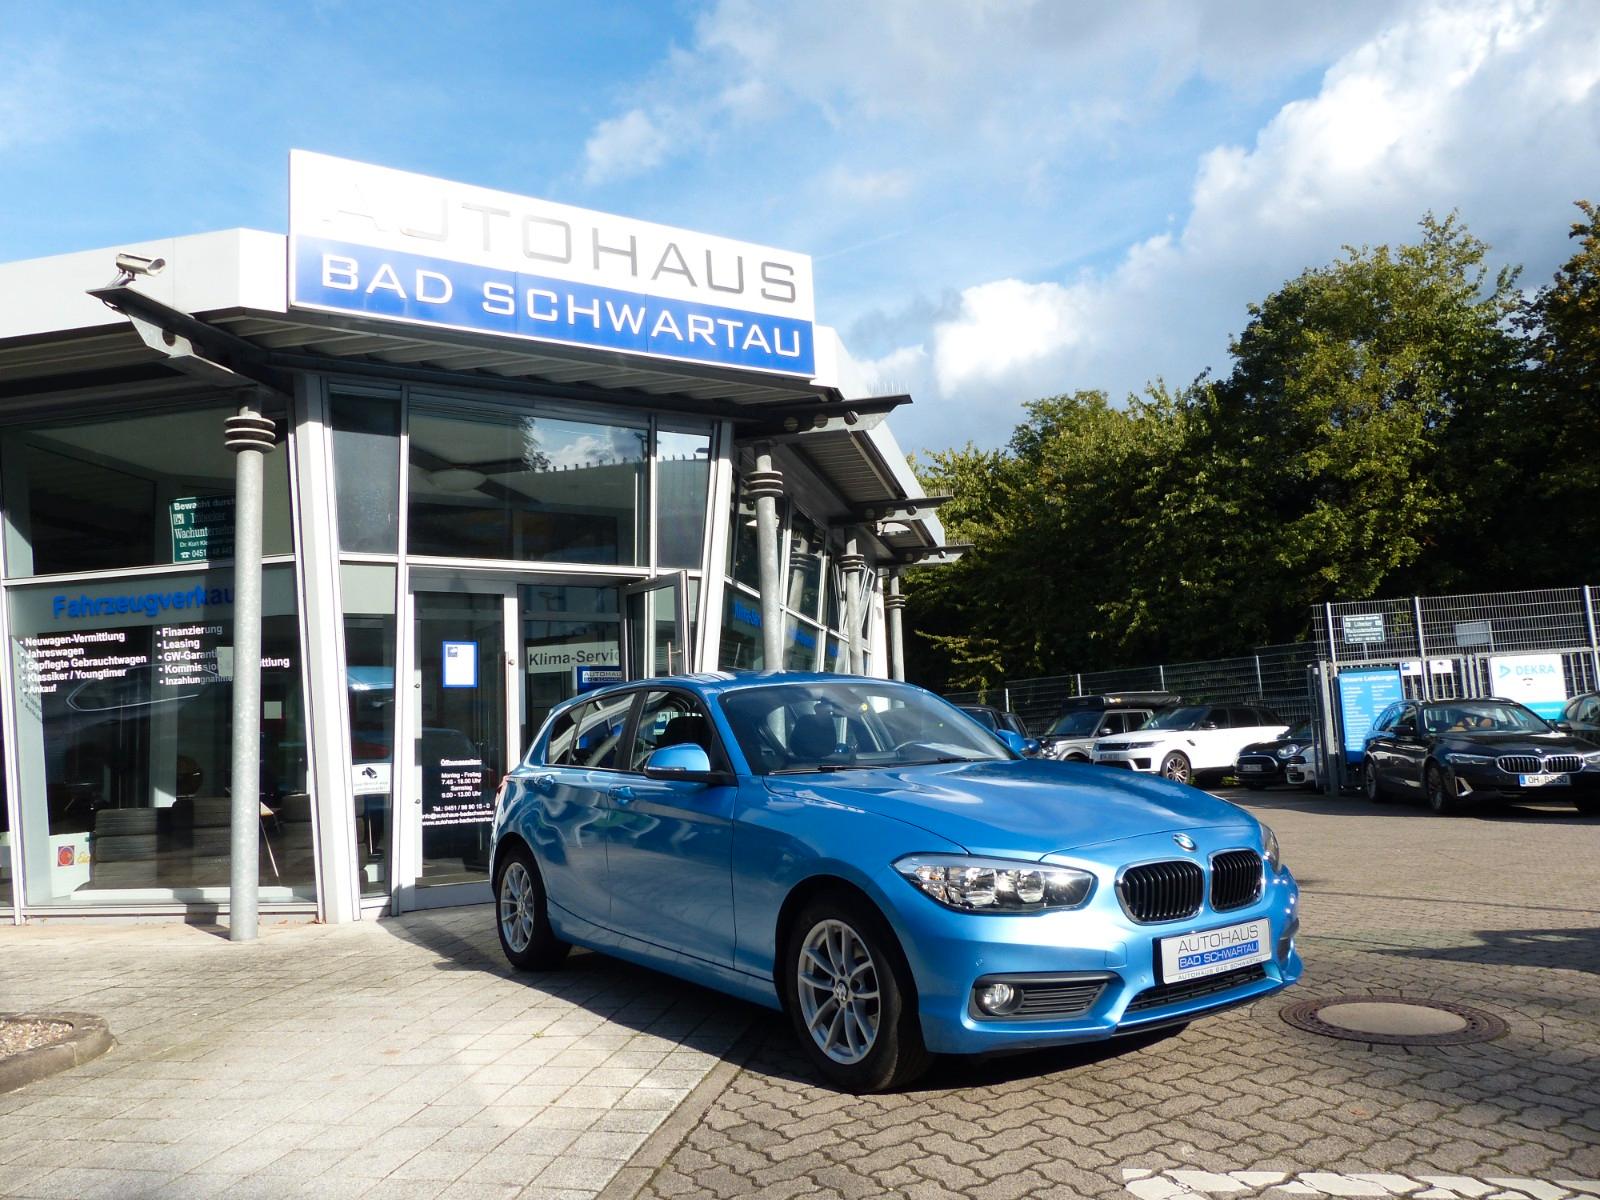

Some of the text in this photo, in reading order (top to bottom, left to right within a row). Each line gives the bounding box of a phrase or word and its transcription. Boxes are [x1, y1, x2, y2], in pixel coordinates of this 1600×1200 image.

[321, 253, 801, 358] BAD SCHWARTAU
[52, 584, 235, 619] Fahrzeugverkau
[162, 625, 223, 637] Finanzierung
[25, 631, 126, 647] Neuwagen-Vermittlung
[163, 638, 200, 650] Leasing
[26, 647, 85, 659] Jahreswagen
[164, 649, 217, 662] GW-Garanti
[27, 655, 147, 672] Gepflegte Gebrauchtwagen
[1515, 664, 1556, 676] DEKRA
[28, 670, 69, 682] Klassiker
[75, 668, 127, 681] Youngtimer
[28, 683, 57, 694] Ankauf
[1178, 925, 1259, 954] AUTOHAUS
[1179, 942, 1259, 968] BAD SCHWARTAU
